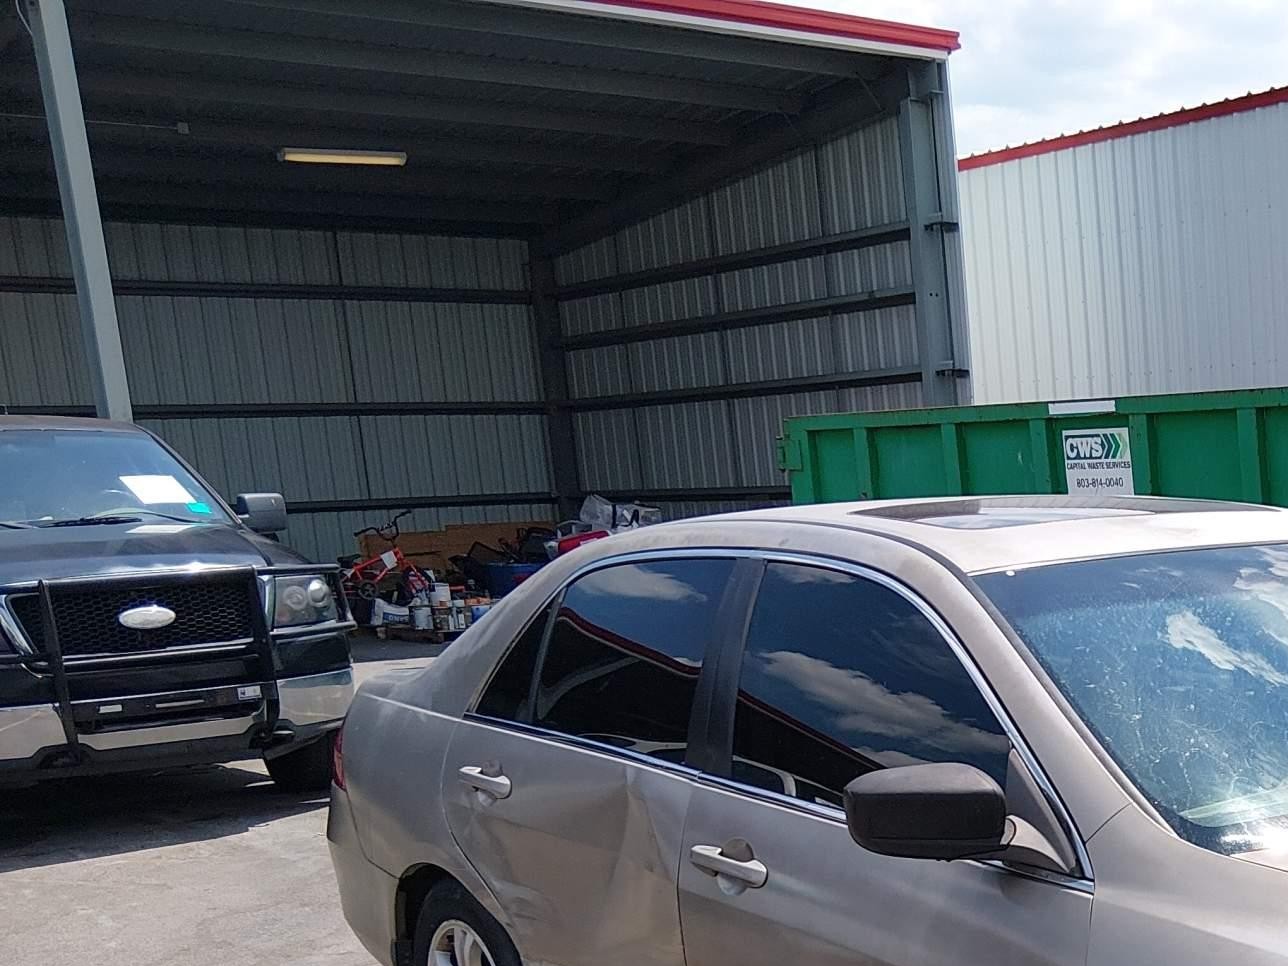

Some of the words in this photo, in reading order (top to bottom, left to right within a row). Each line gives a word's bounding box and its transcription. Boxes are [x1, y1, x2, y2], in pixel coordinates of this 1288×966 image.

[1066, 437, 1103, 459] CWS
[1067, 462, 1086, 470] CAPITAL
[1087, 462, 1105, 470] WASTE
[1106, 461, 1131, 469] SERVICES
